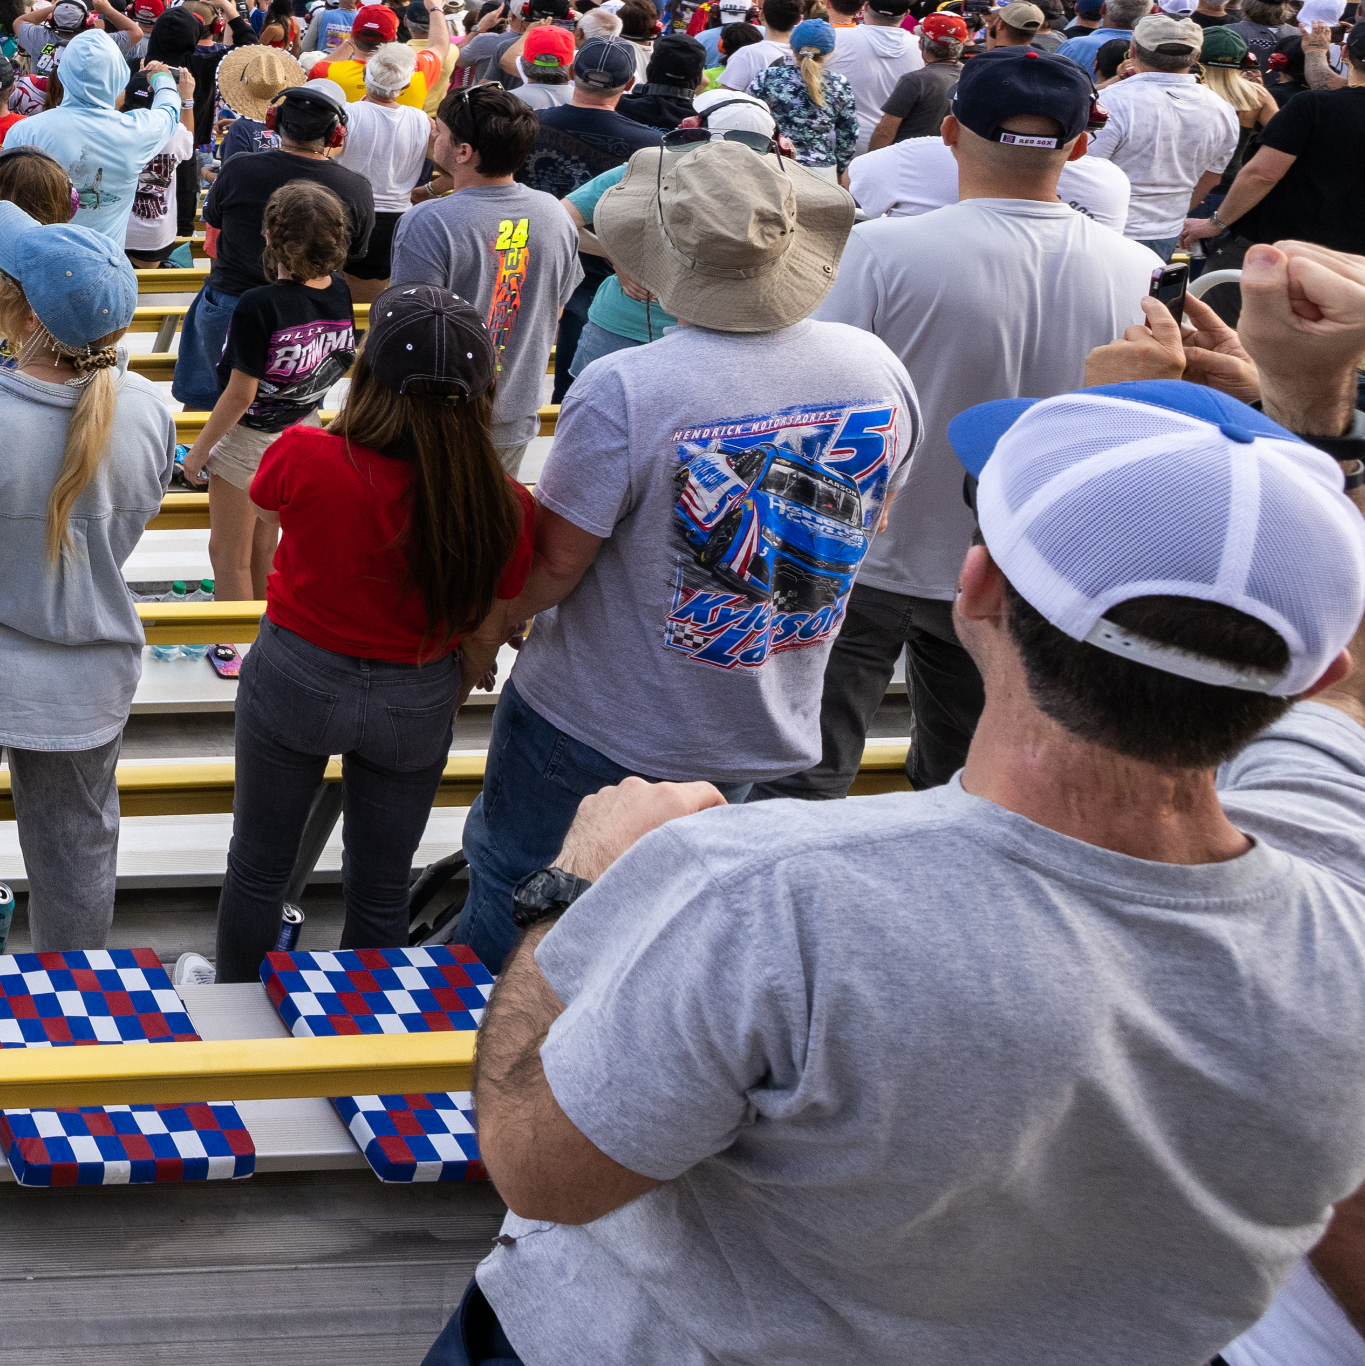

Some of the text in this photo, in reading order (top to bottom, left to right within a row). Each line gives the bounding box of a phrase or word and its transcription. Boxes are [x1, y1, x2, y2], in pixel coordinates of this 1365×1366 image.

[496, 218, 529, 250] 24
[673, 411, 831, 441] HENDRICK MOTORSPORTS
[824, 406, 897, 480] 5
[823, 476, 857, 497] LARSON
